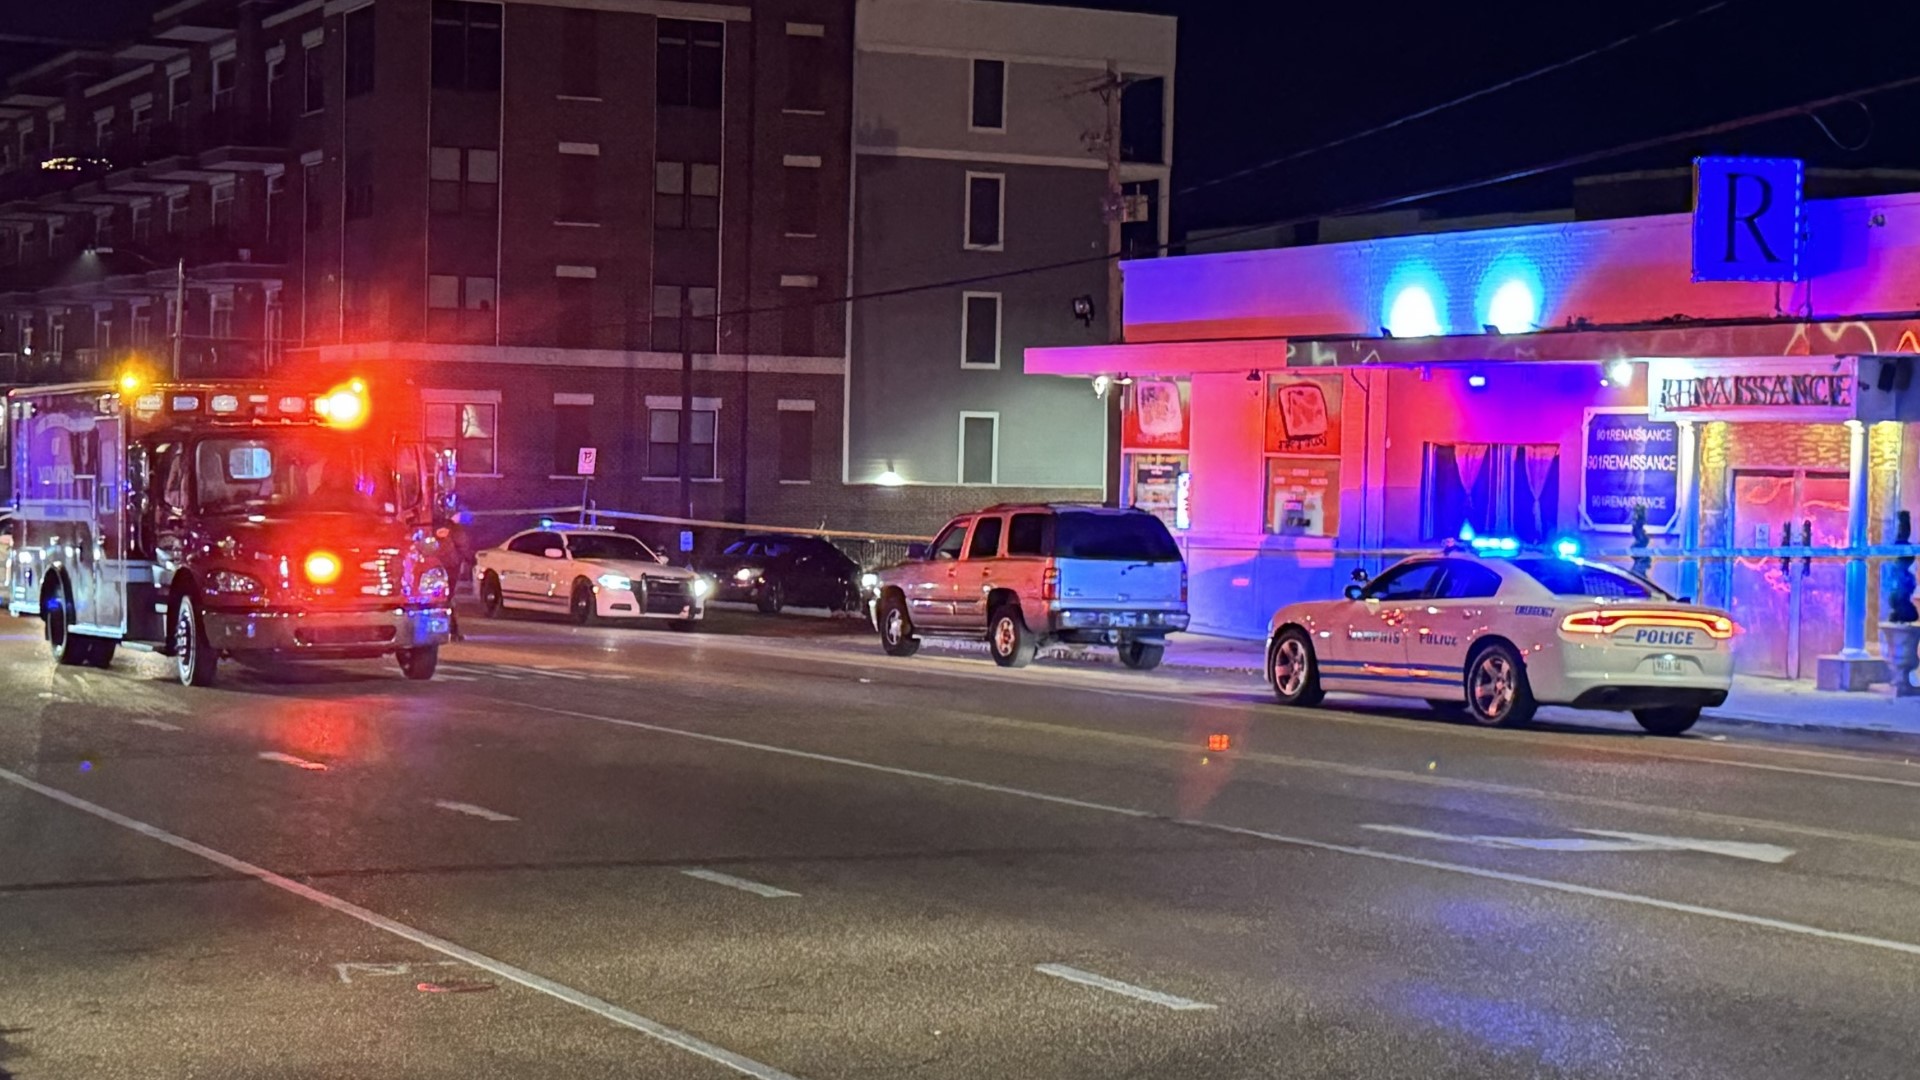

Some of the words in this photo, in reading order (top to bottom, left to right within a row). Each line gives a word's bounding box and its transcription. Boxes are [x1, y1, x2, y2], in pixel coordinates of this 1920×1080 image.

[1724, 172, 1781, 263] R
[1660, 374, 1852, 408] RENAISSANCE
[1596, 428, 1672, 442] 901RENAISSANCE
[1588, 454, 1676, 471] 901RENAISSANCE
[1635, 629, 1695, 645] POLICE
